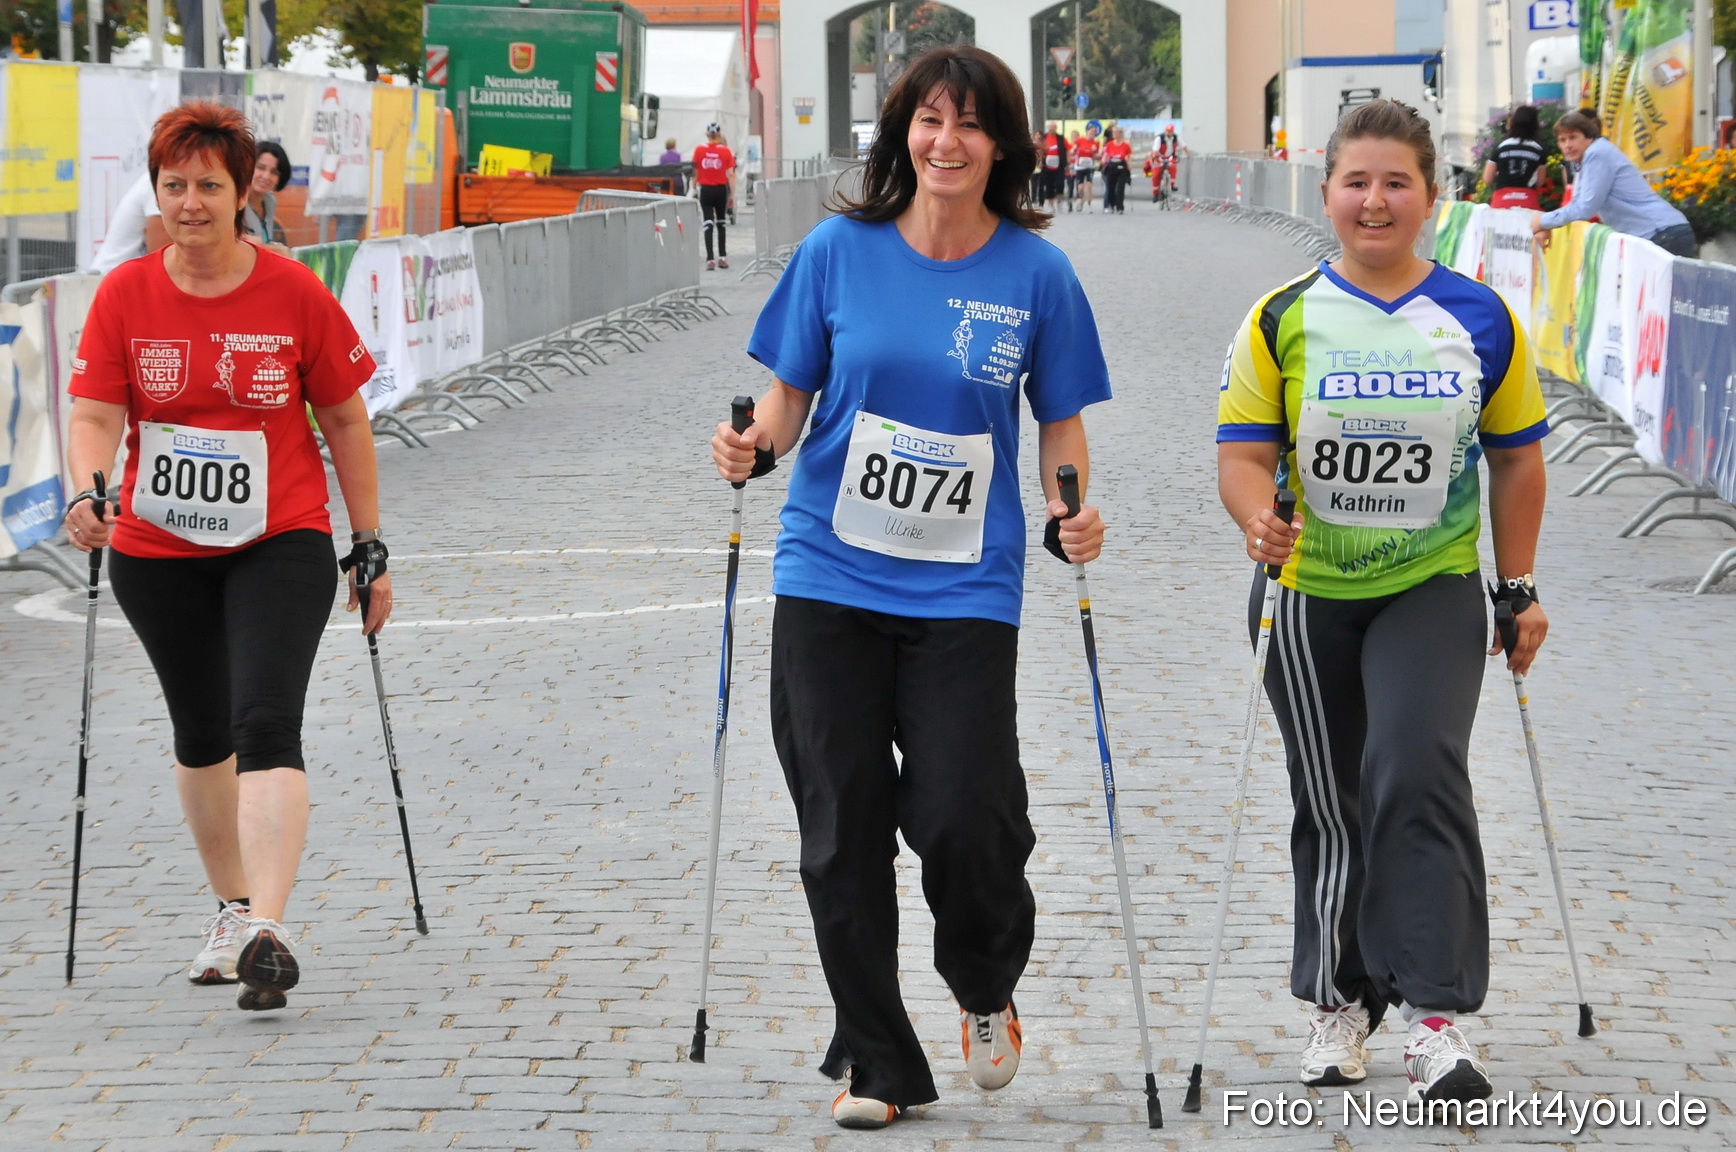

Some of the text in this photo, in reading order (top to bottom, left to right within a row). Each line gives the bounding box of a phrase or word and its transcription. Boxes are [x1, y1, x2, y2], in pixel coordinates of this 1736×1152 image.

[484, 74, 559, 90] Neumarkter
[470, 86, 572, 108] Lammsbräu
[947, 298, 1031, 321] 12. NEUMARKTE
[963, 309, 1022, 328] STADTLAUF
[210, 333, 294, 346] 11. NEUMARKTER
[223, 342, 280, 353] STADTLAUF
[138, 357, 182, 368] WIEDER
[140, 348, 180, 358] IMMER
[1326, 350, 1413, 368] TEAM
[141, 367, 180, 382] NEU
[144, 382, 179, 391] MARKT
[1318, 371, 1464, 401] BOCK
[1340, 418, 1408, 433] BOCK
[173, 433, 226, 451] BOCK
[892, 433, 956, 458] BOCK
[1312, 439, 1433, 484] 8023
[151, 454, 251, 504] 8008
[859, 452, 975, 515] 8074
[1330, 491, 1406, 513] Kathrin
[165, 508, 228, 531] Andrea
[884, 515, 925, 540] Ulrike
[1336, 535, 1407, 575] www.
[717, 698, 725, 730] nordic
[1103, 762, 1114, 795] nordic
